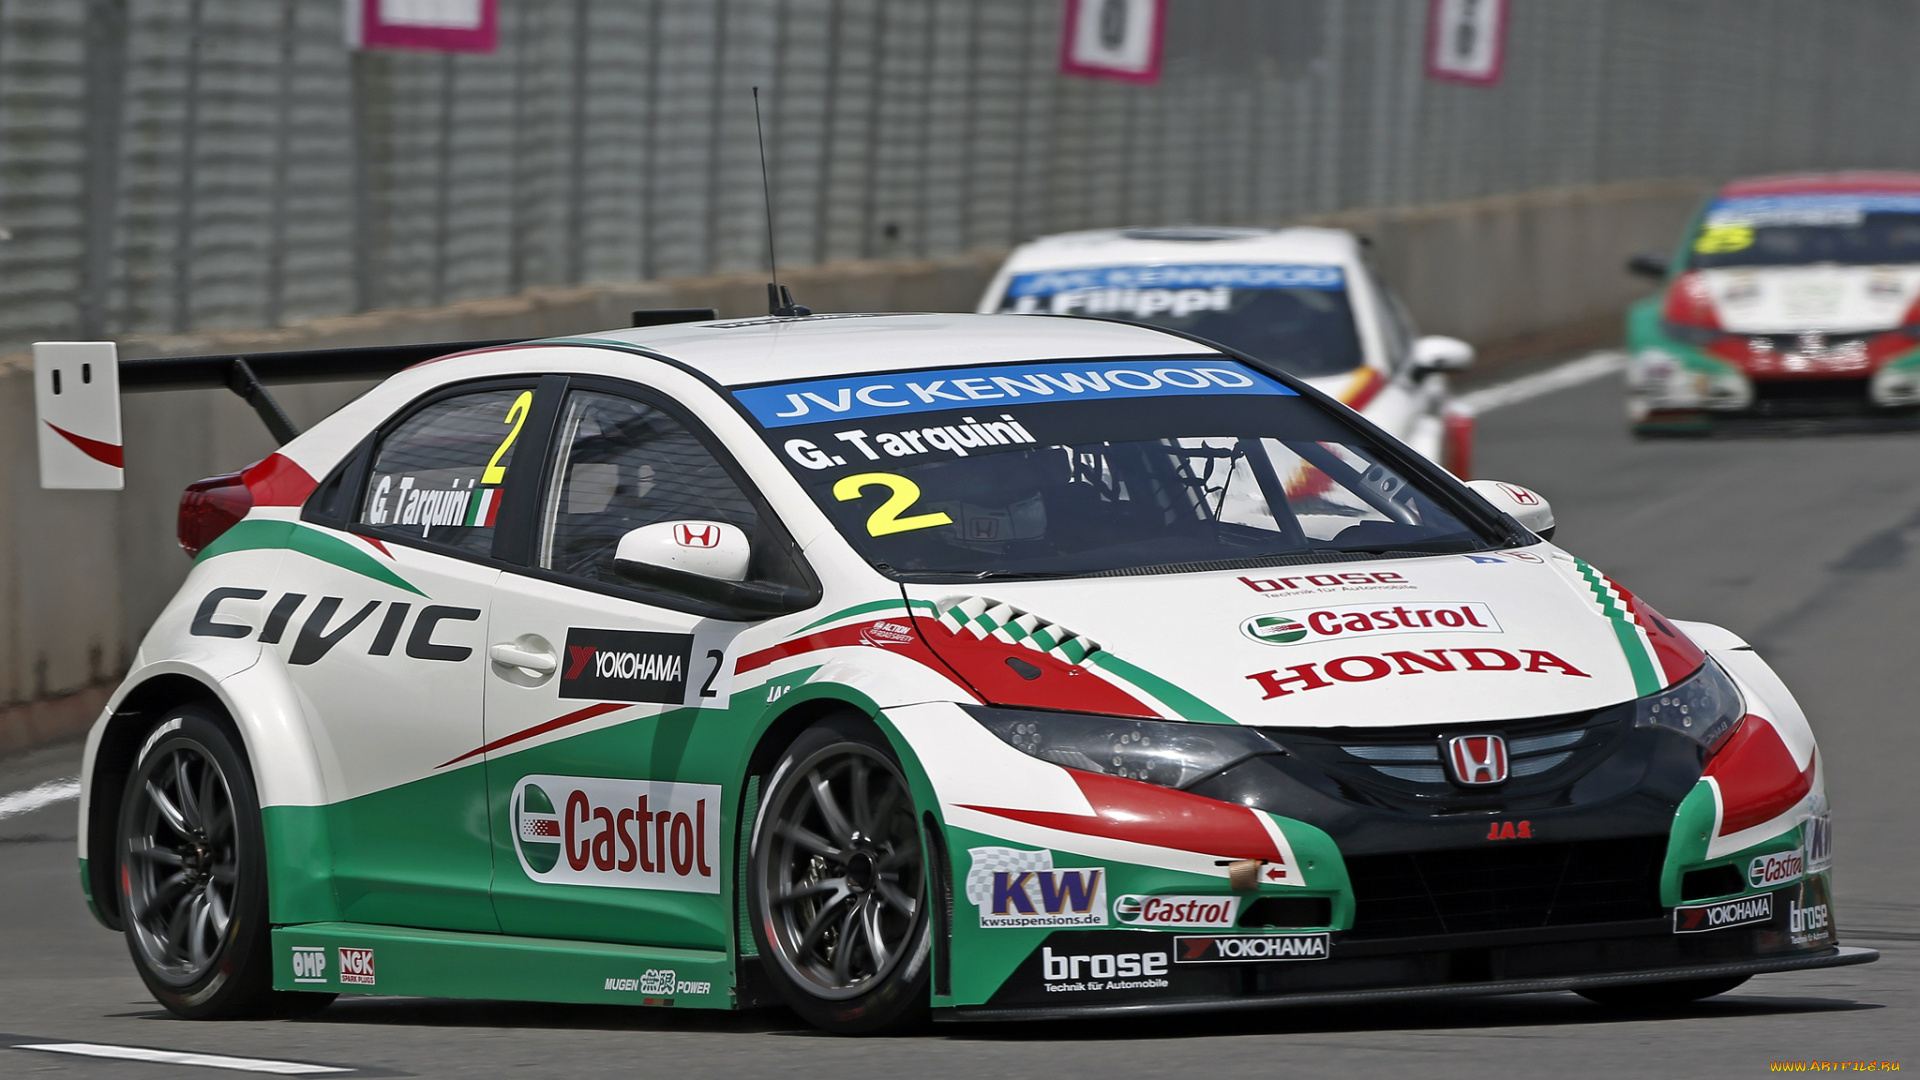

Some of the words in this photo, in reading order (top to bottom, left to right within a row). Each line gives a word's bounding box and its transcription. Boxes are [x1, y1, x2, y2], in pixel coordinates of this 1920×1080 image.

[1051, 285, 1232, 317] Filippi
[480, 390, 533, 485] 2
[784, 438, 848, 470] G.
[833, 413, 1037, 460] Tarquini
[370, 475, 392, 525] G.
[393, 476, 476, 538] Tarquini
[832, 472, 954, 538] 2
[1236, 571, 1409, 593] brose
[1262, 589, 1315, 599] Technik
[1341, 584, 1418, 592] Automobile
[189, 586, 482, 666] CIVIC
[882, 623, 911, 634] ACTION
[1307, 605, 1488, 636] Castrol
[595, 650, 682, 683] YOKOHAMA
[699, 649, 724, 698] 2
[1245, 647, 1593, 701] HONDA
[564, 789, 712, 878] Castrol
[1486, 820, 1532, 840] JAS
[991, 869, 1103, 916] KW
[980, 914, 1102, 928] kwsuspensions.de
[1143, 898, 1232, 924] Castrol
[1706, 897, 1770, 926] YOKOHAMA
[1790, 900, 1829, 933] brose
[340, 950, 374, 975] NGK
[1215, 937, 1325, 958] YOKOHAMA
[292, 951, 327, 978] OMP
[1042, 946, 1168, 981] brose
[341, 974, 358, 983] SPARK
[358, 976, 374, 985] PLUGS
[604, 977, 639, 991] MUGEN
[676, 980, 711, 995] POWER
[1044, 982, 1086, 993] Technik
[1087, 981, 1104, 991] für
[1105, 978, 1169, 991] Automobile
